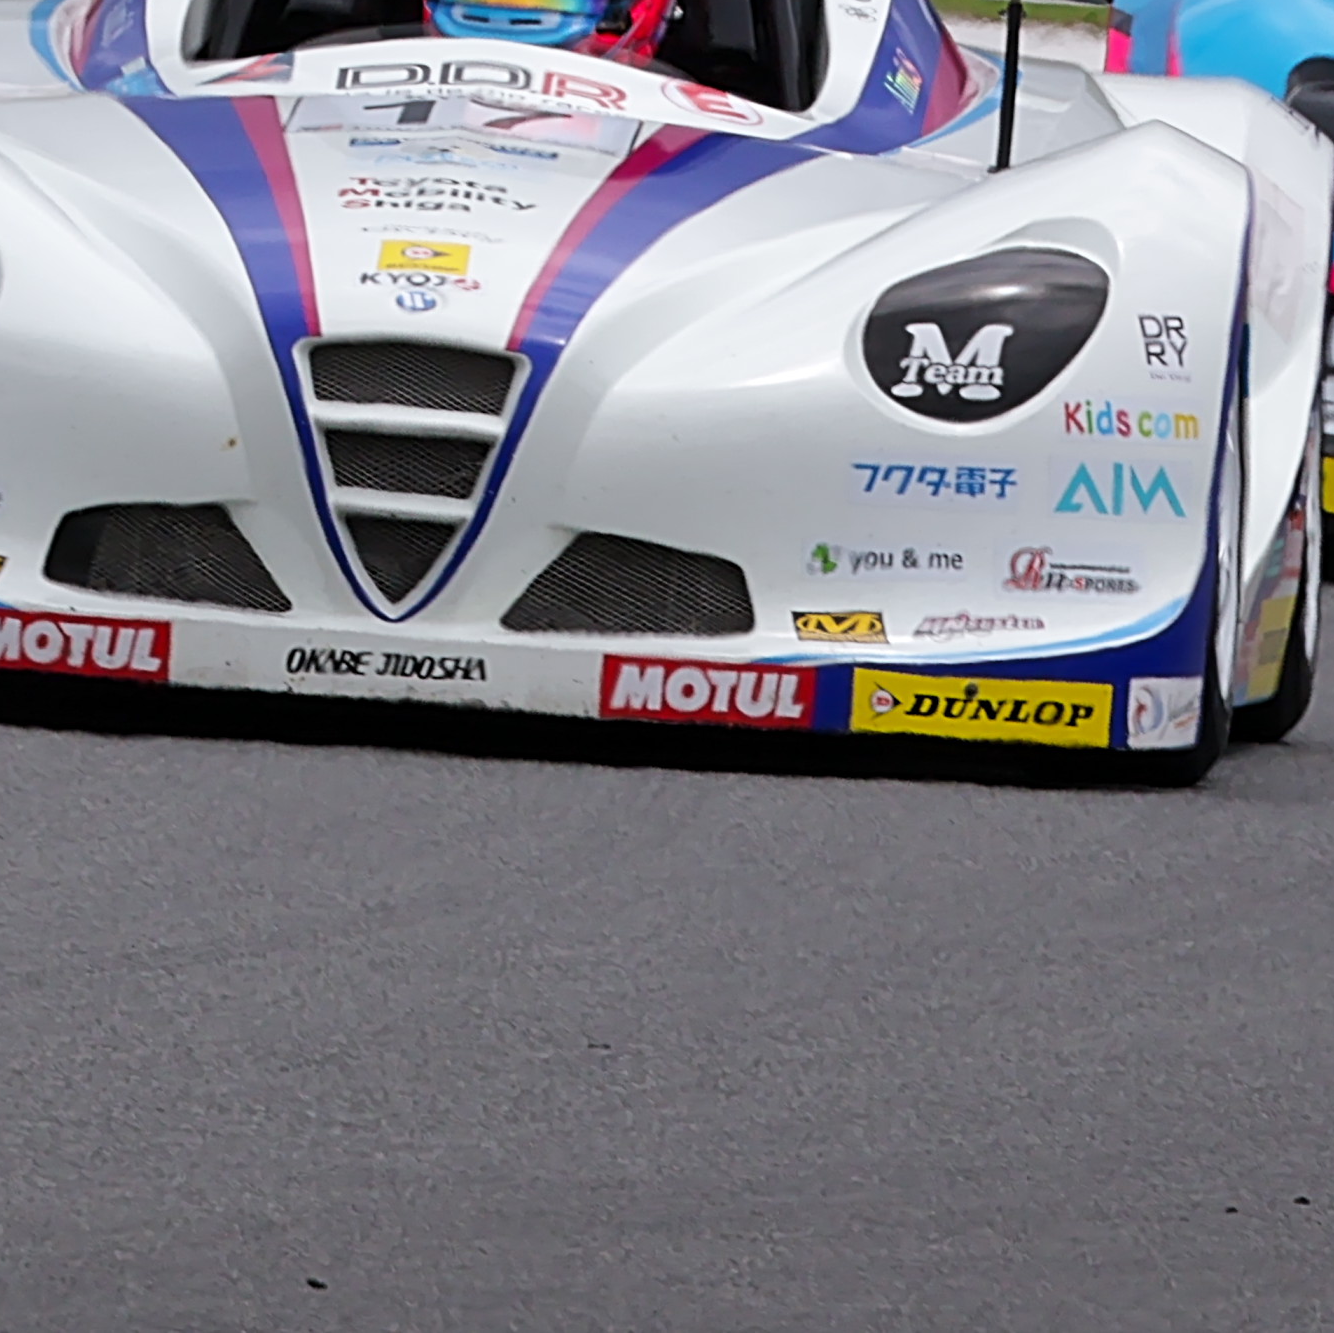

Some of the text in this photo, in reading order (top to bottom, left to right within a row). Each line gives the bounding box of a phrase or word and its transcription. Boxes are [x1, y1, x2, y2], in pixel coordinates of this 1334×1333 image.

[363, 98, 572, 130] 17
[337, 187, 537, 211] Mobility
[348, 176, 508, 194] Toyota
[341, 198, 471, 212] Shiga
[899, 357, 1004, 386] Team
[1063, 399, 1200, 440] Kids com
[1054, 461, 1187, 518] AIM
[849, 547, 964, 575] you & me
[285, 647, 487, 682] OKABE JIDOSHA
[609, 665, 804, 719] MOTUL
[905, 692, 1095, 728] DUNLOP
